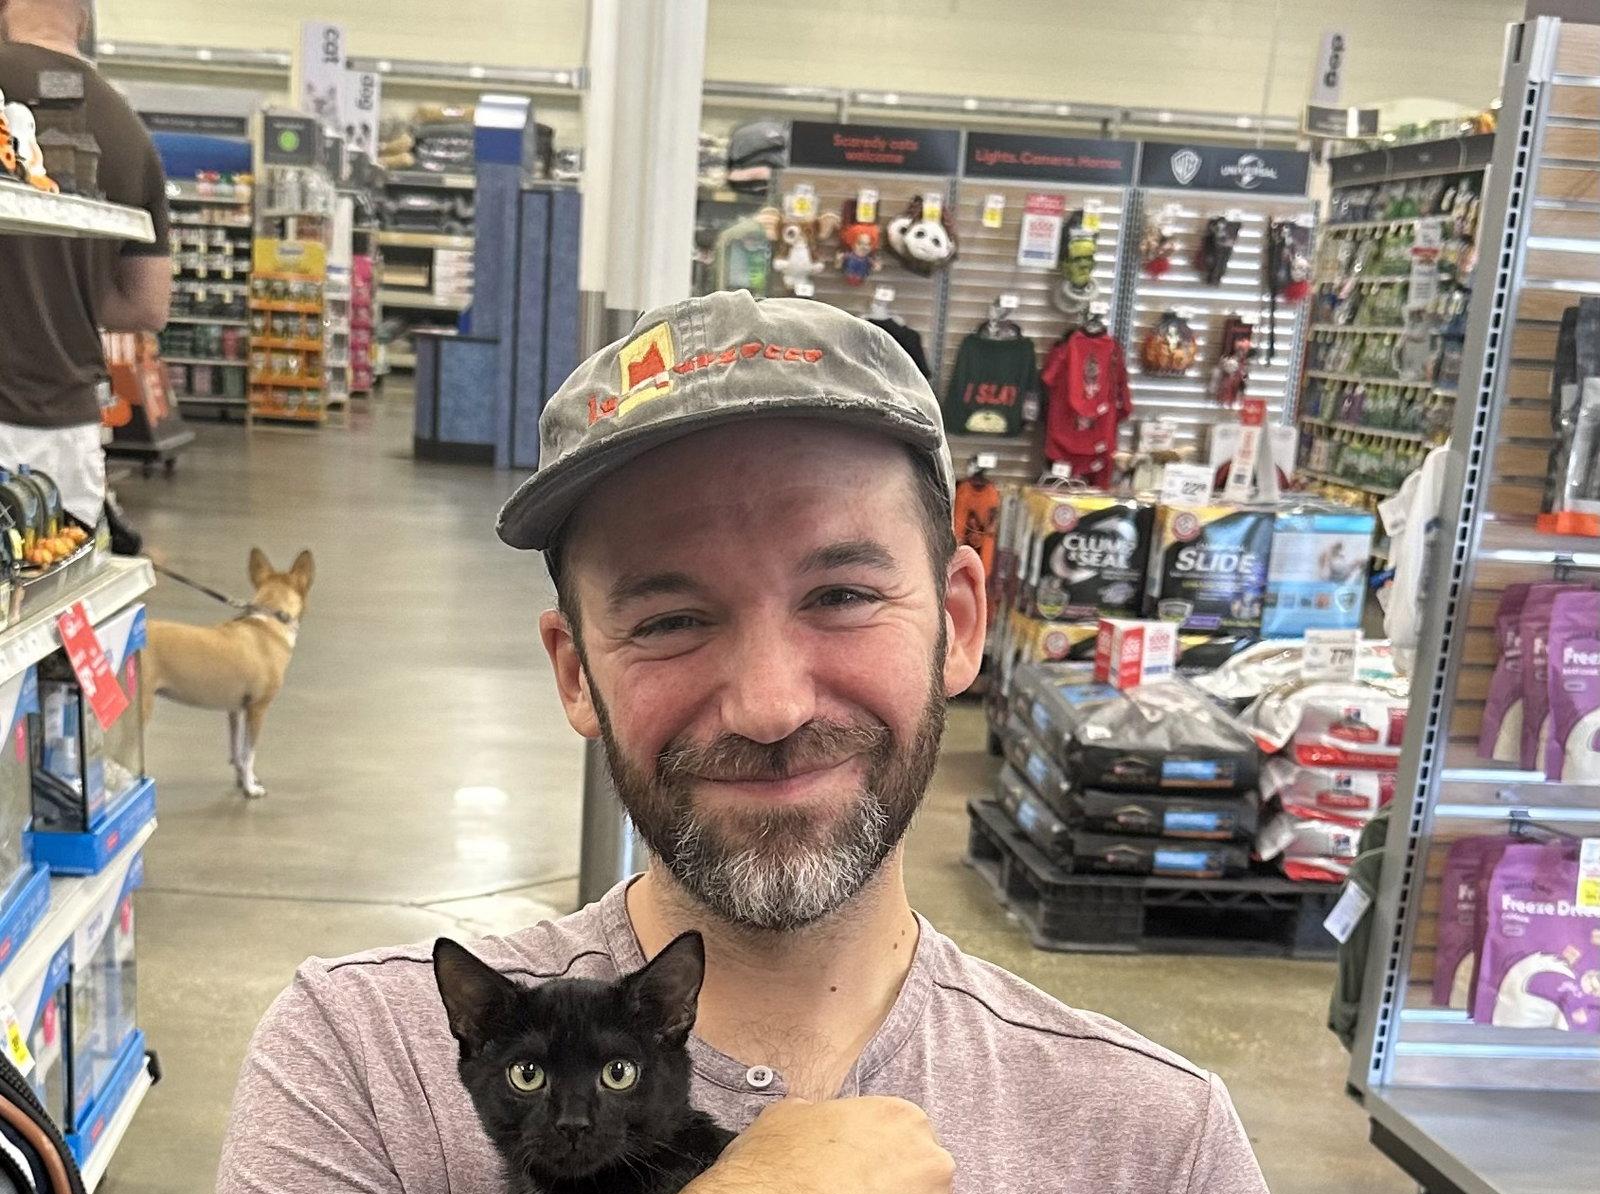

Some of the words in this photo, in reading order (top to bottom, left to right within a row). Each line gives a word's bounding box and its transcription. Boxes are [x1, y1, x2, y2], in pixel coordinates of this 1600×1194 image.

[322, 27, 340, 63] cat
[1175, 545, 1256, 574] SLIDE
[1563, 647, 1600, 665] Free
[1501, 894, 1556, 915] Freeze
